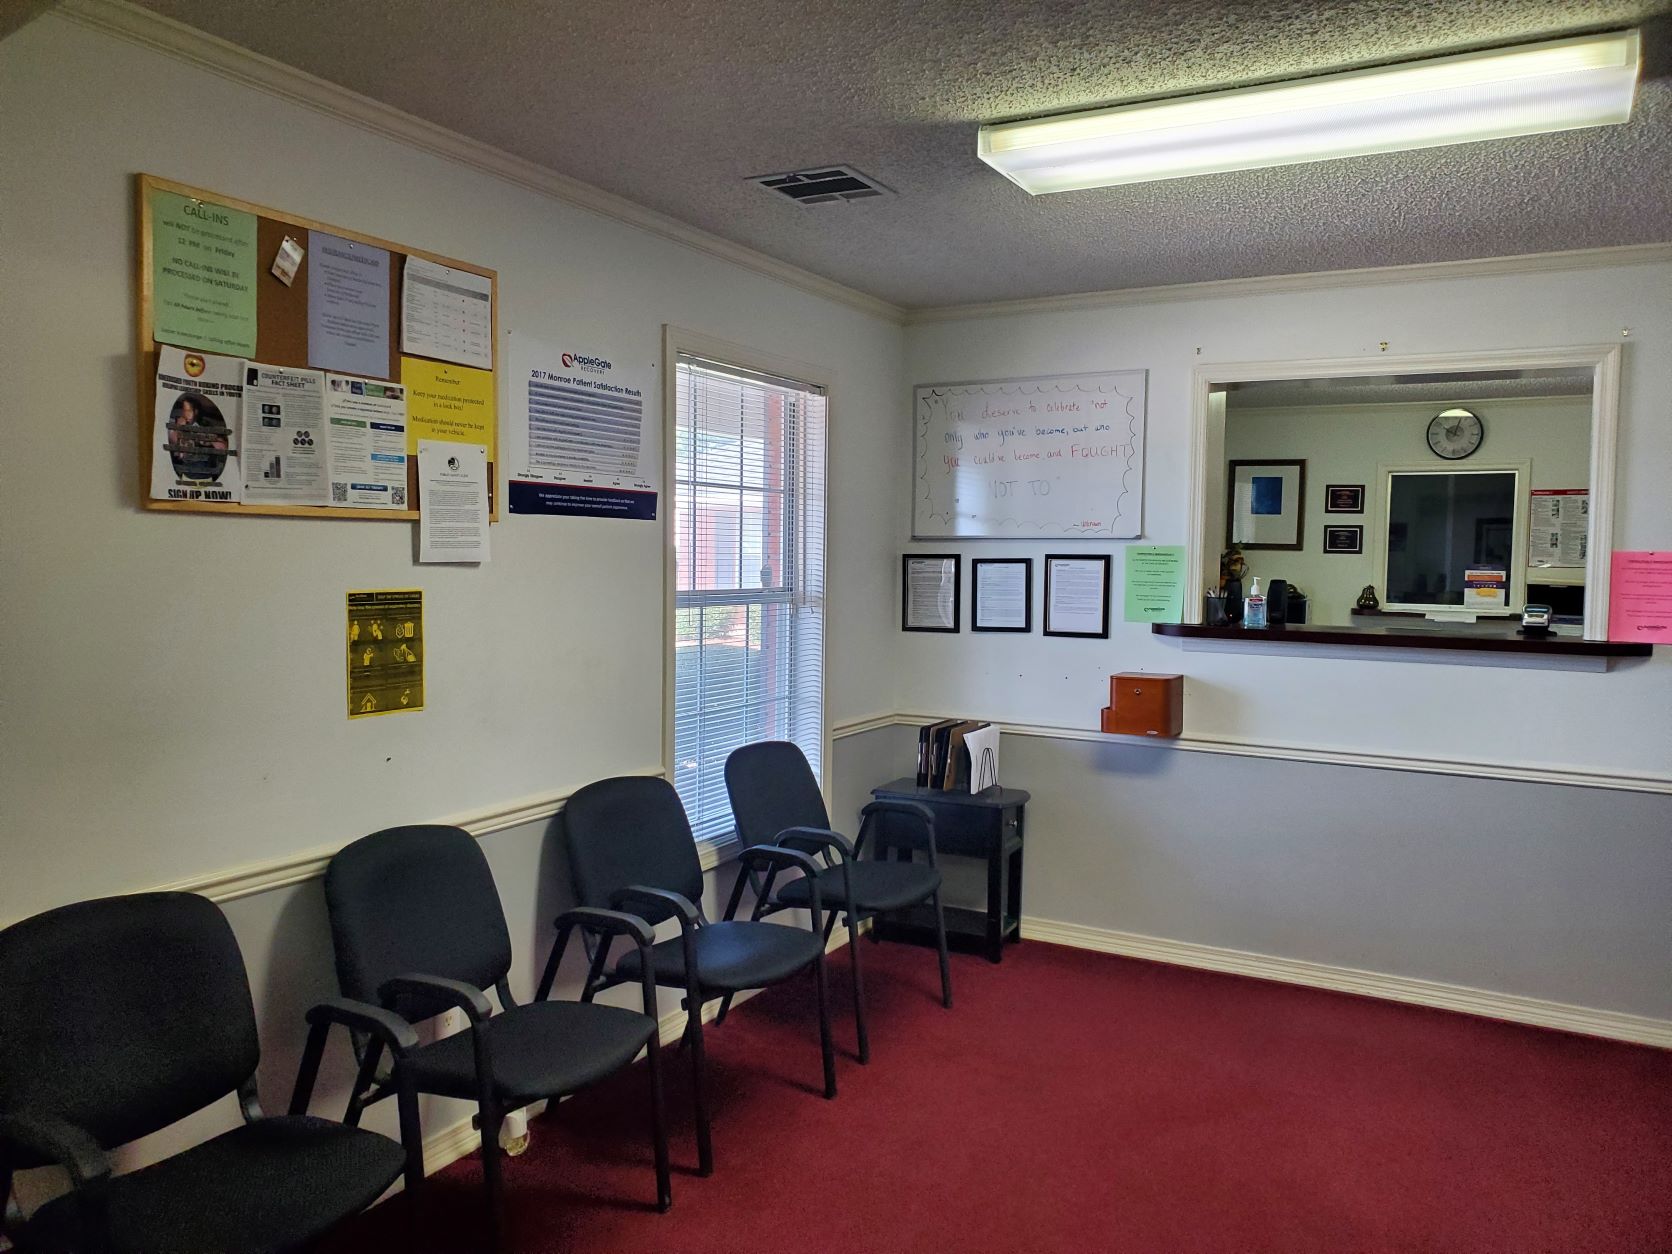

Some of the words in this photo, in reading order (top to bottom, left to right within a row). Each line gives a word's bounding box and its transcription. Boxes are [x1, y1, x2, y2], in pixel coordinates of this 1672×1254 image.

[183, 205, 229, 226] CALL-INS
[163, 267, 201, 281] PROCESSED
[214, 279, 249, 291] SATURDAY
[573, 353, 611, 370] AppleGate
[271, 379, 286, 387] FACT
[531, 369, 547, 379] 2017
[547, 373, 571, 384] Monroe
[573, 378, 592, 388] Patient
[593, 380, 624, 394] Satisfaction
[625, 387, 642, 397] Results
[1046, 401, 1081, 412] celebrate
[412, 415, 439, 425] Medication
[944, 430, 964, 450] only
[973, 429, 989, 441] who
[997, 427, 1026, 447] you've
[943, 454, 960, 474] you
[1046, 448, 1062, 458] and
[167, 488, 188, 499] SIGN
[189, 489, 202, 500] UP
[204, 490, 232, 500] NOW!
